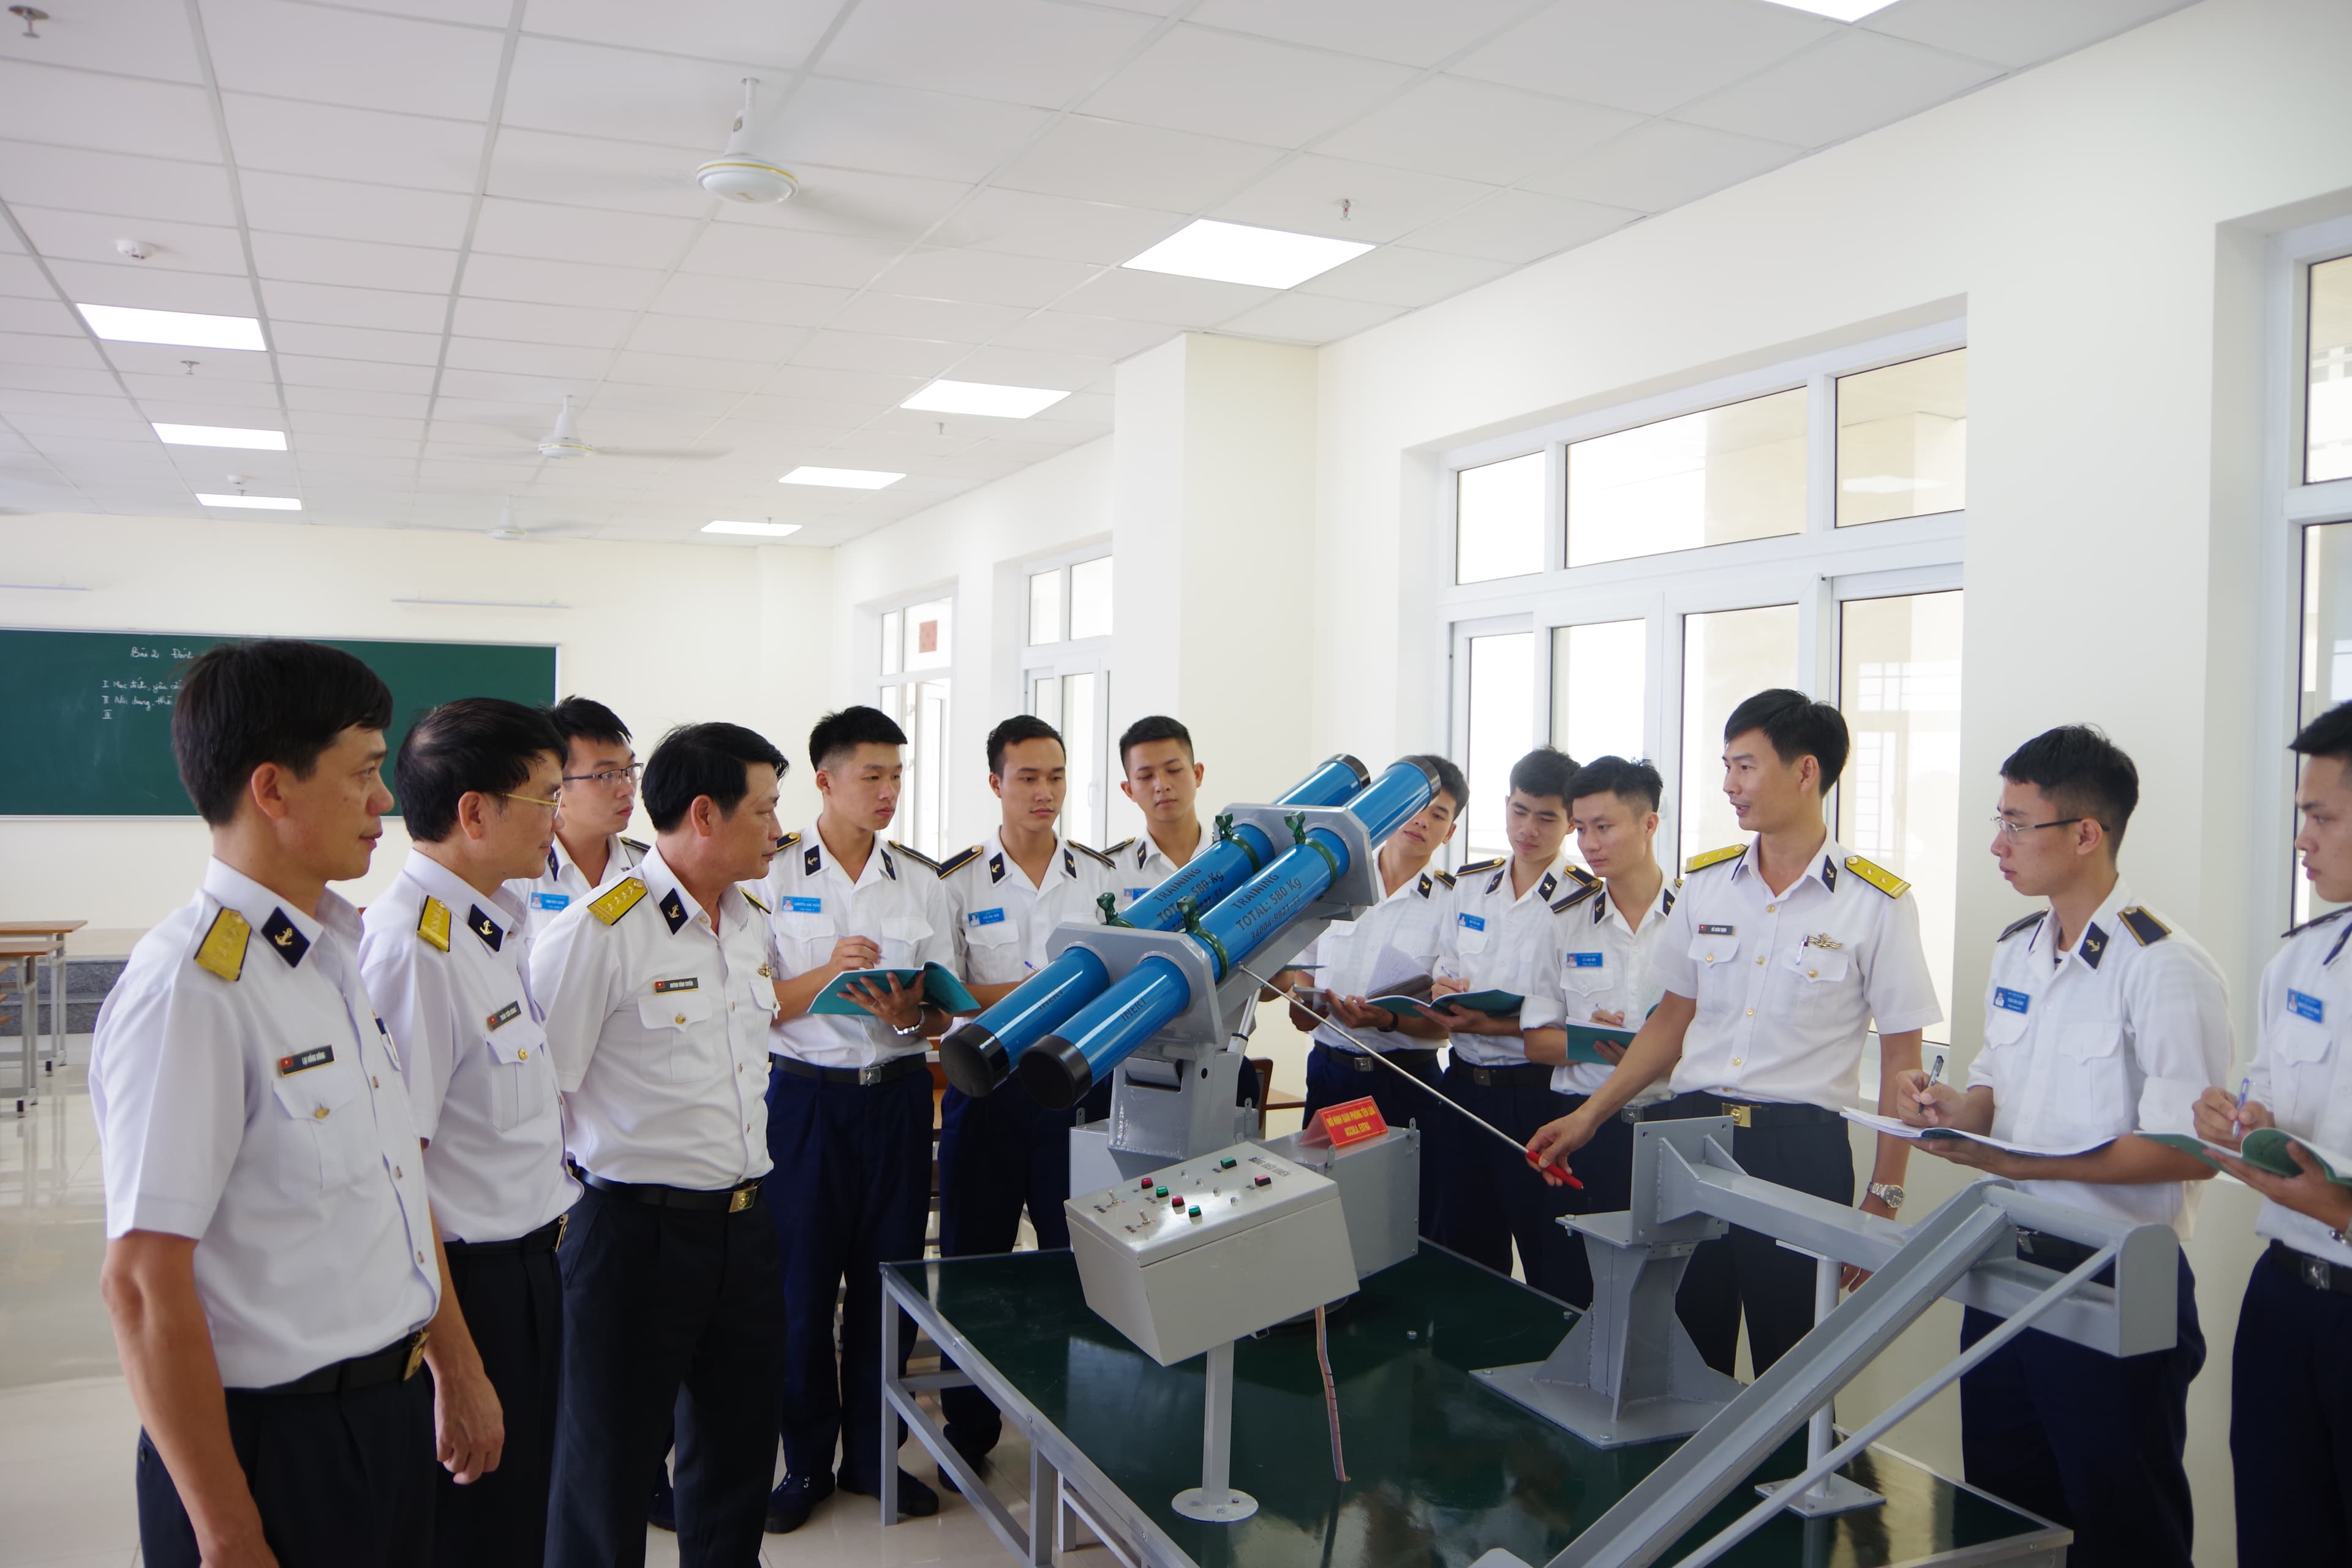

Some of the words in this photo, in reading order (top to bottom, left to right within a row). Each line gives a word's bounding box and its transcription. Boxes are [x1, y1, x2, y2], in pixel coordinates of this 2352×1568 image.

[1153, 867, 1201, 902] TRAINING
[1208, 871, 1224, 883] Kg
[1231, 873, 1280, 910] TRAINING
[1235, 902, 1271, 930] TOTAL:
[1269, 886, 1288, 905] 580
[1286, 877, 1302, 891] Kg
